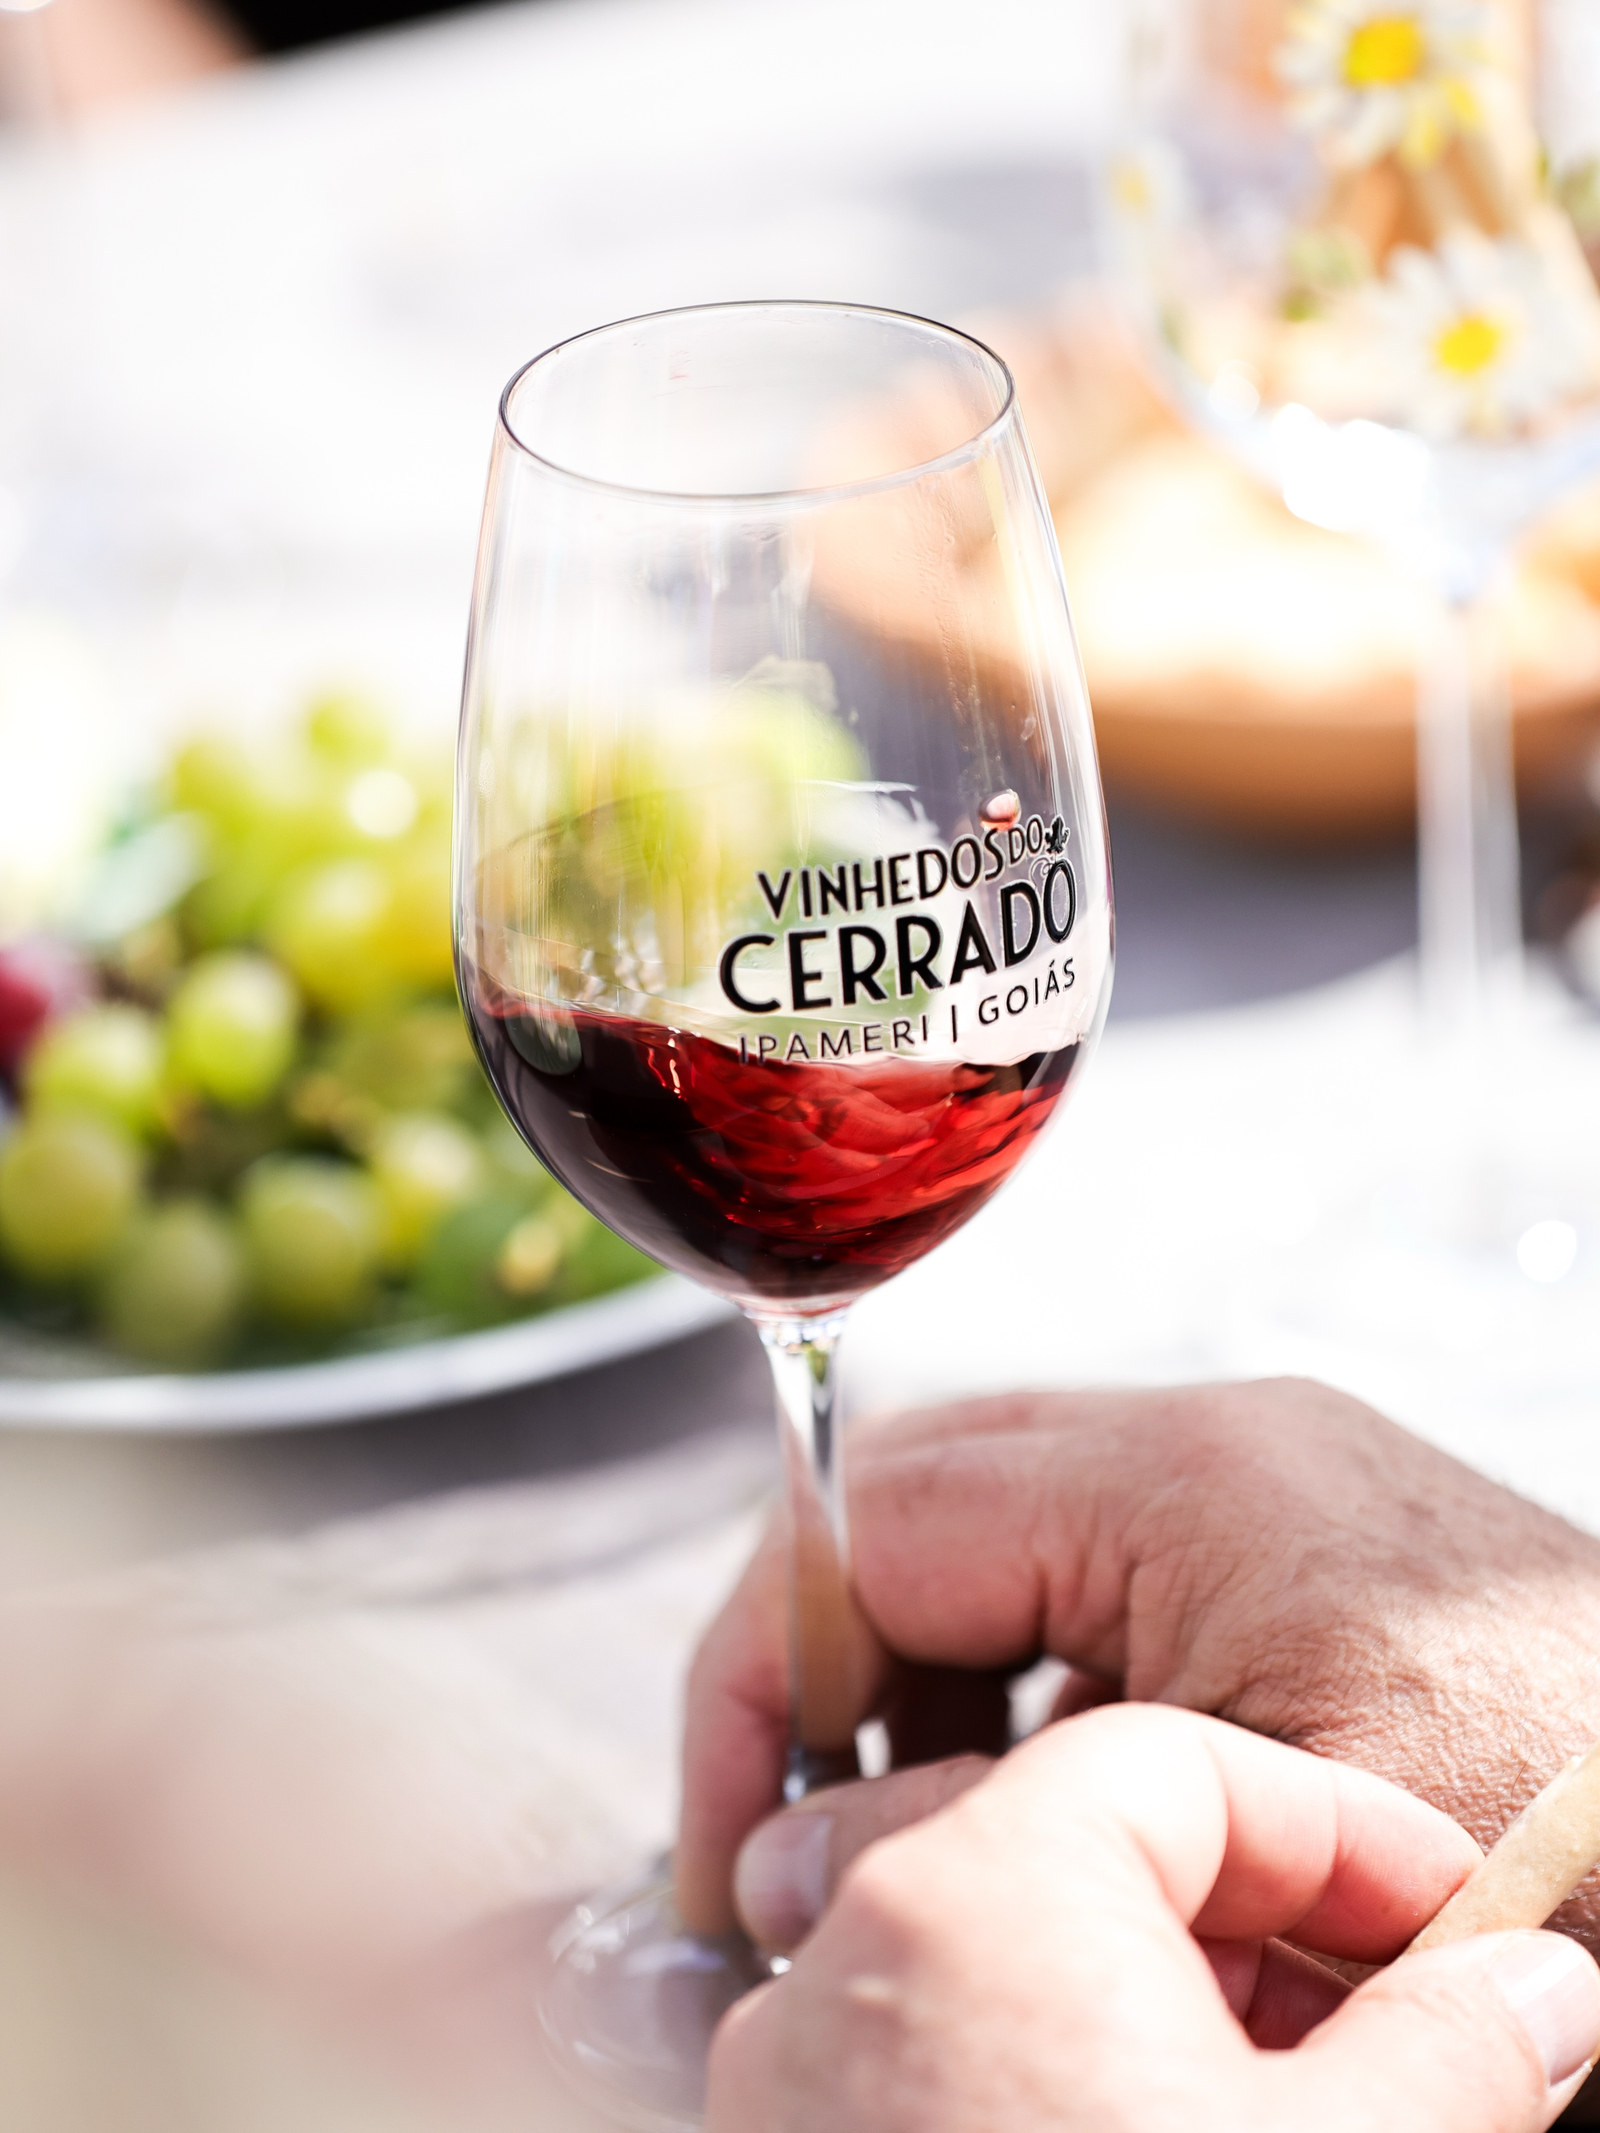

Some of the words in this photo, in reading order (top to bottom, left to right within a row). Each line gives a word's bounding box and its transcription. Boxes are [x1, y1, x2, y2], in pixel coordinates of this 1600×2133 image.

[757, 827, 1004, 919] VINHEDOS
[1008, 817, 1043, 865] DO
[719, 860, 1076, 1013] CERRADO
[739, 1014, 928, 1064] IPAMERI
[978, 957, 1076, 1025] GOIÁS
